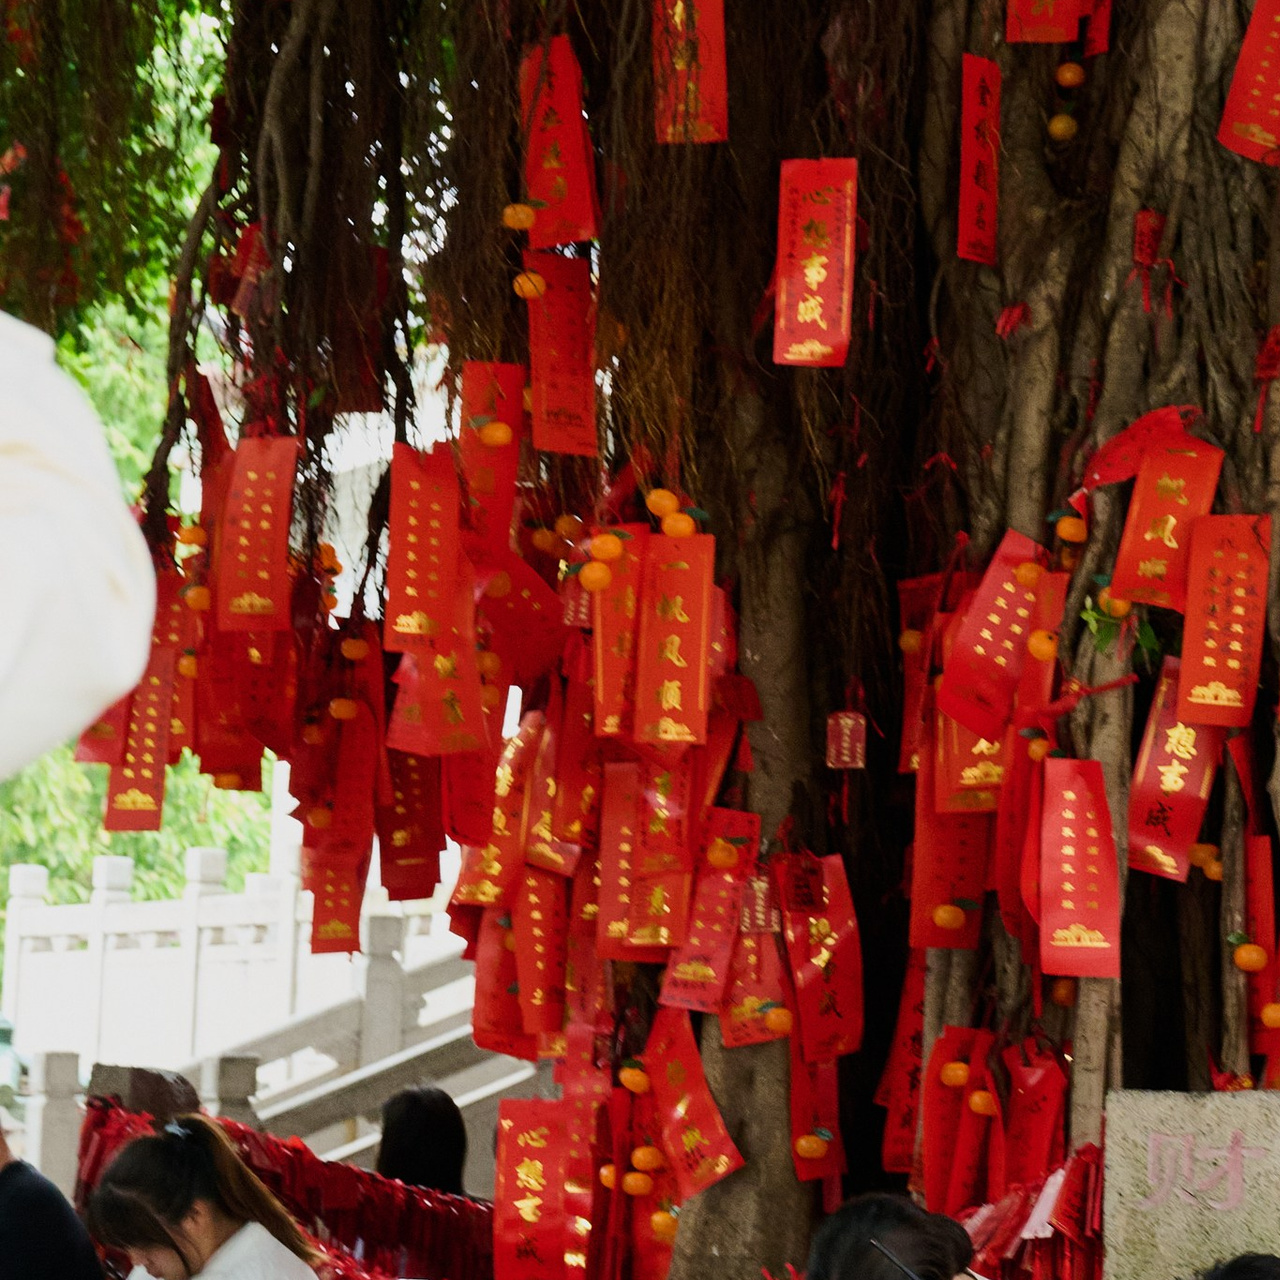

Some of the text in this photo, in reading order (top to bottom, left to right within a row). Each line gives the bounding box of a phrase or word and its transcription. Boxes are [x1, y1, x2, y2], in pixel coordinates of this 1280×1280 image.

[797, 185, 834, 332] 心想事成
[514, 1125, 548, 1265] 心想事成
